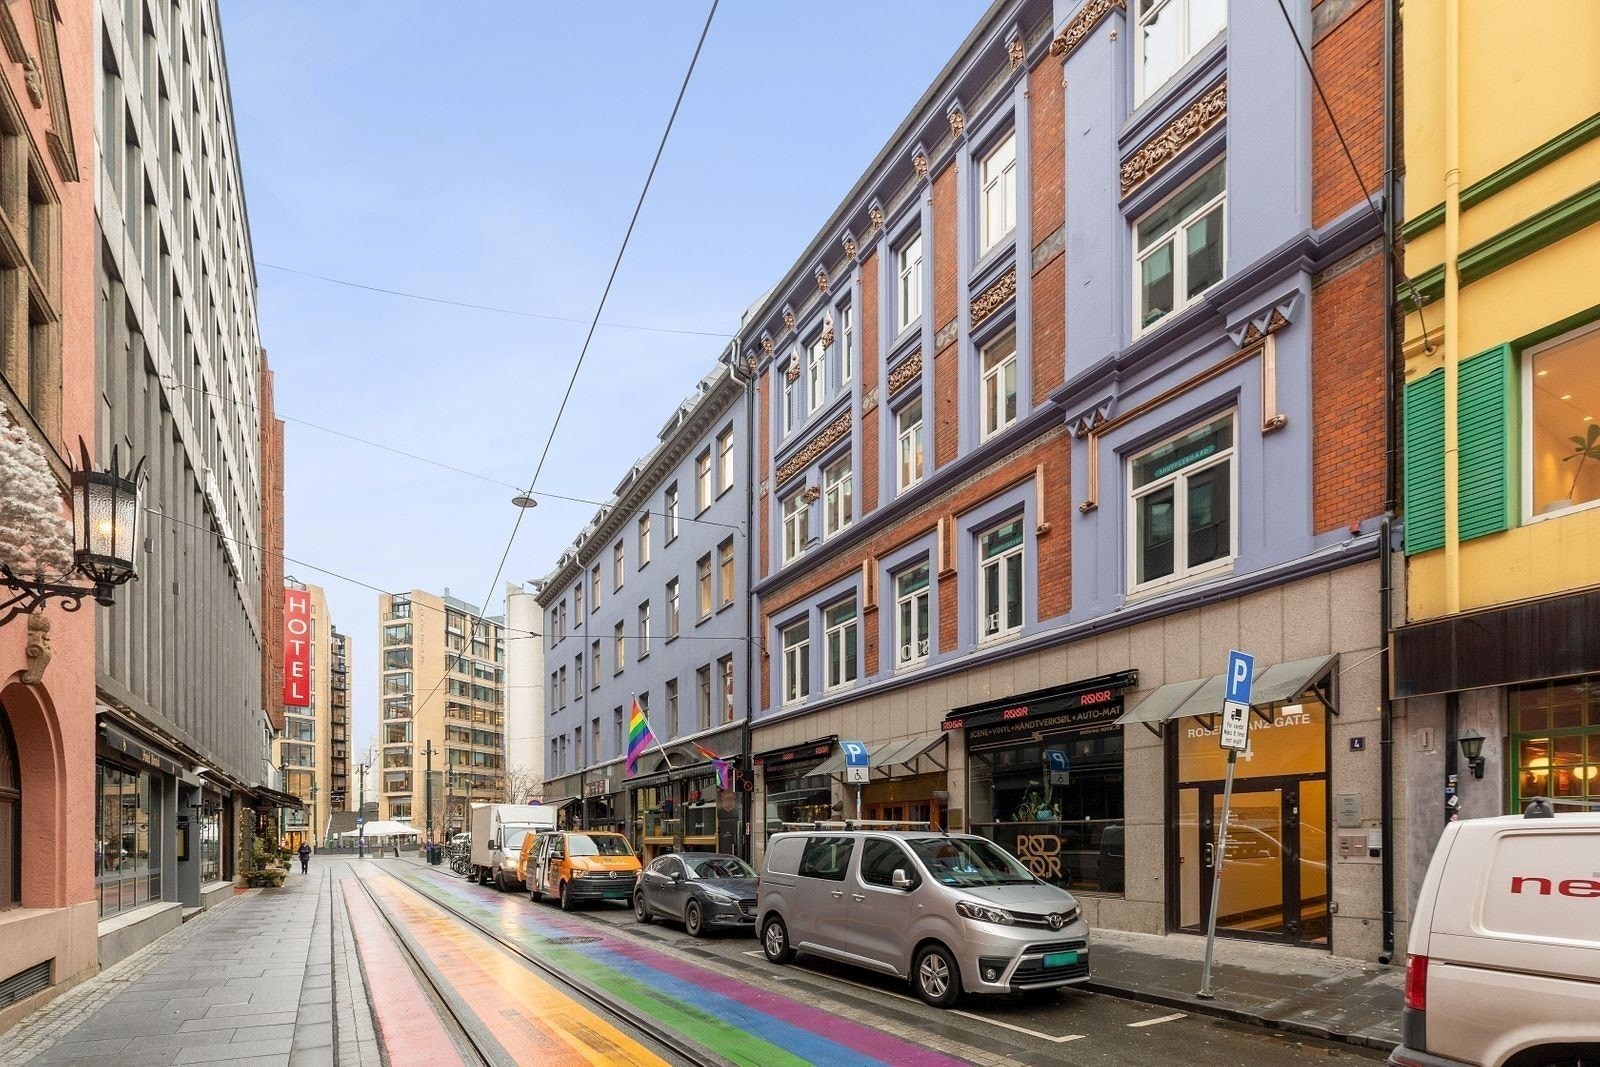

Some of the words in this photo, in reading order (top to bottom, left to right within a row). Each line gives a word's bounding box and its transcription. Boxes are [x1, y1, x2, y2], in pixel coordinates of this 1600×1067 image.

[287, 597, 308, 699] HOTEL
[1232, 658, 1248, 695] P
[1275, 713, 1311, 728] GATE
[846, 744, 861, 763] P
